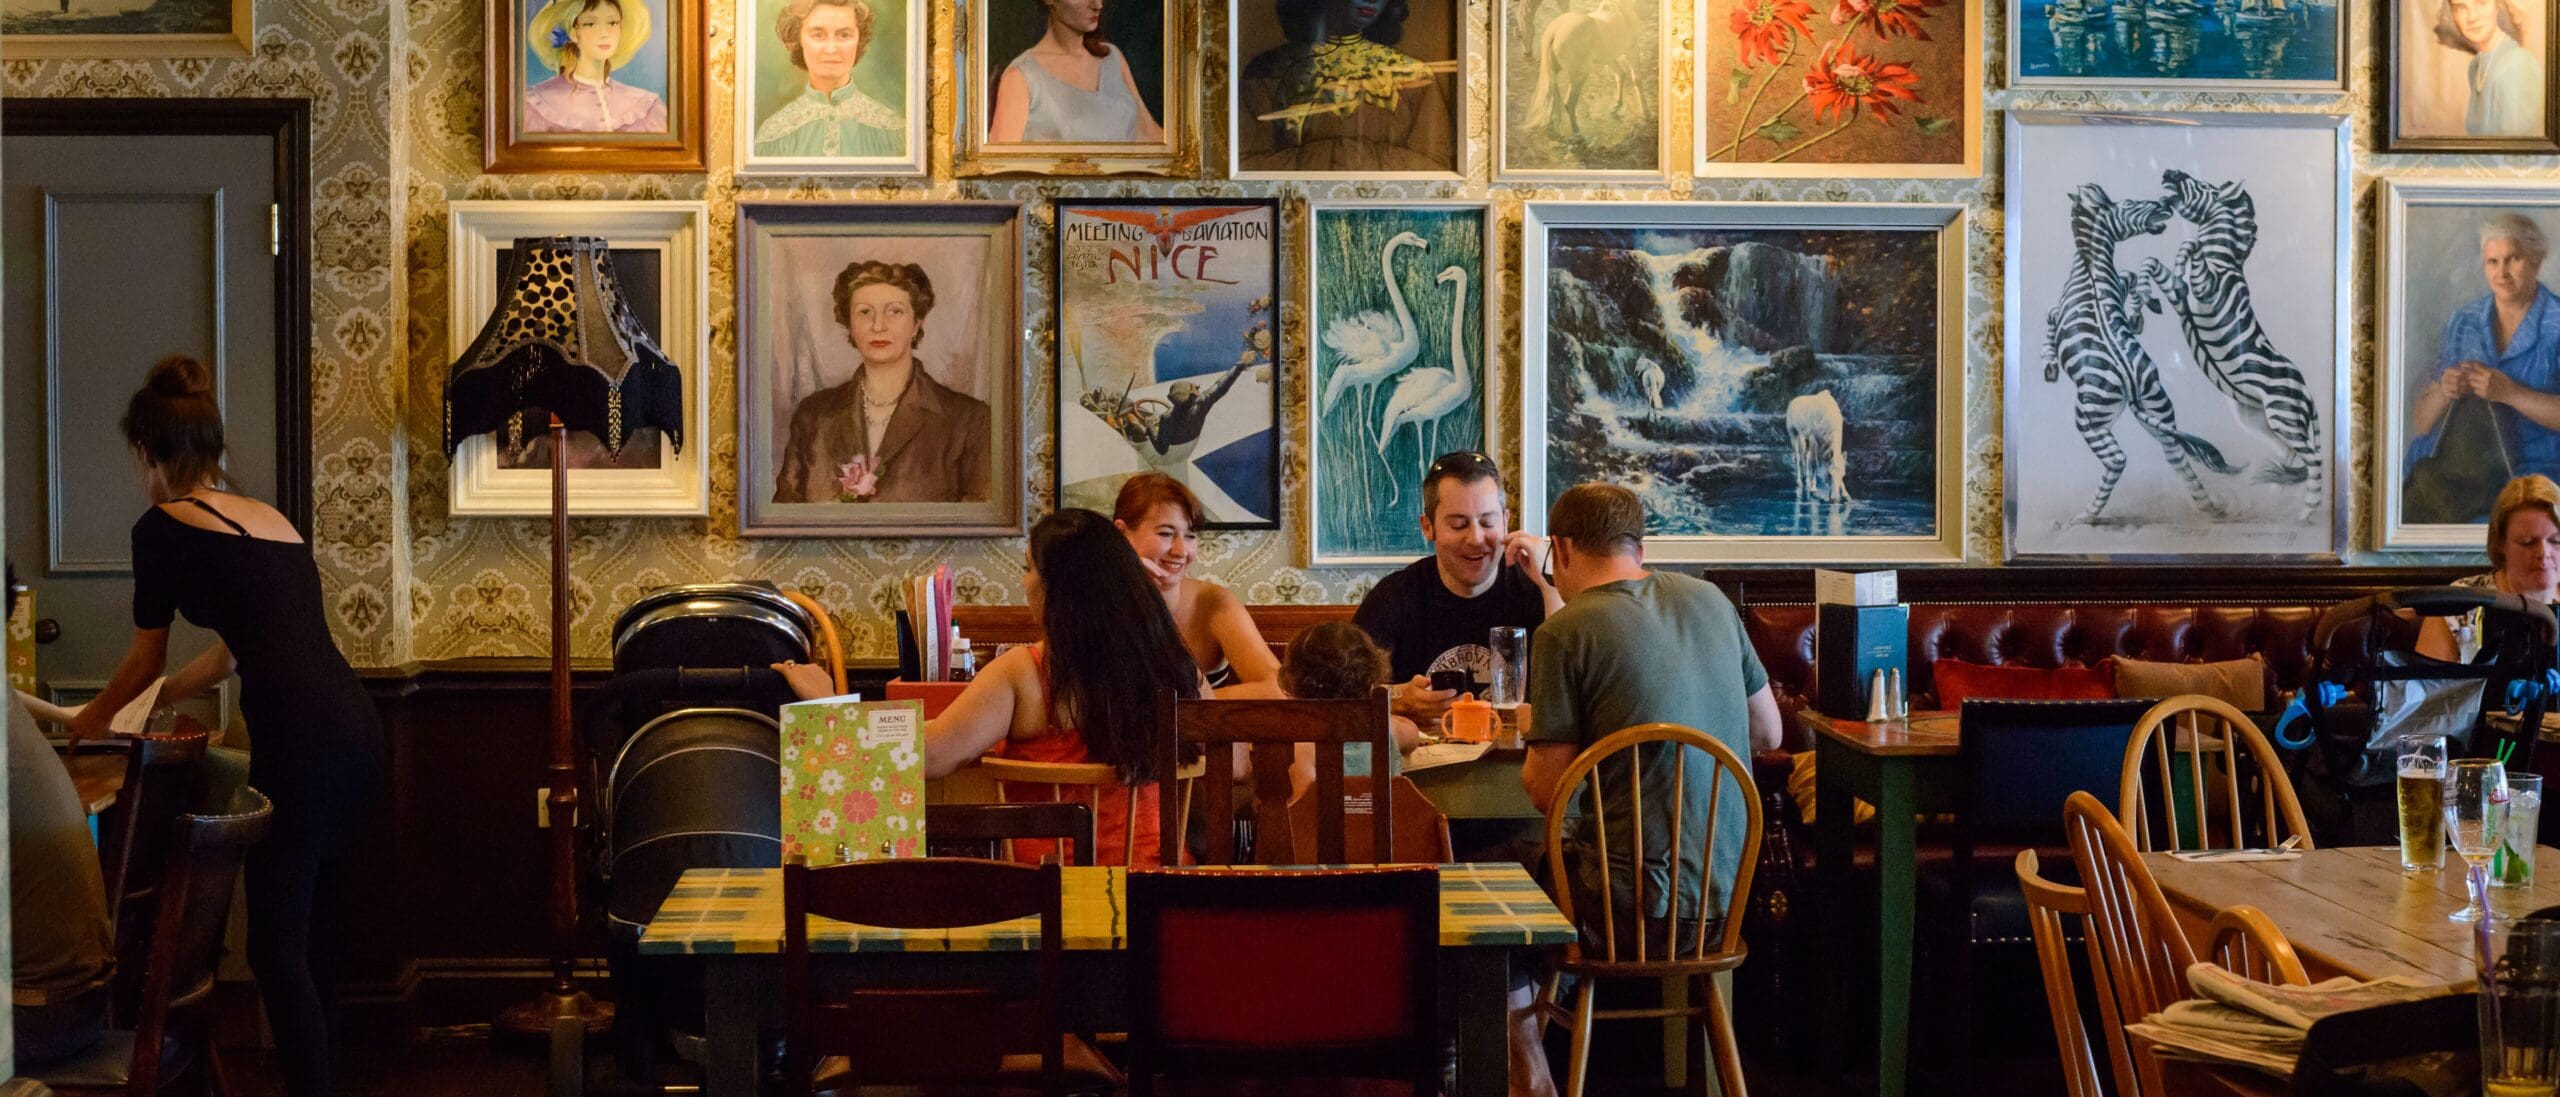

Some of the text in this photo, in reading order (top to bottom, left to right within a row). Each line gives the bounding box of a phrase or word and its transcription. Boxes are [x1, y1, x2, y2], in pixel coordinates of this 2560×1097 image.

[1065, 222, 1144, 242] MEETING
[1103, 244, 1241, 285] NICE
[878, 715, 906, 724] MENU
